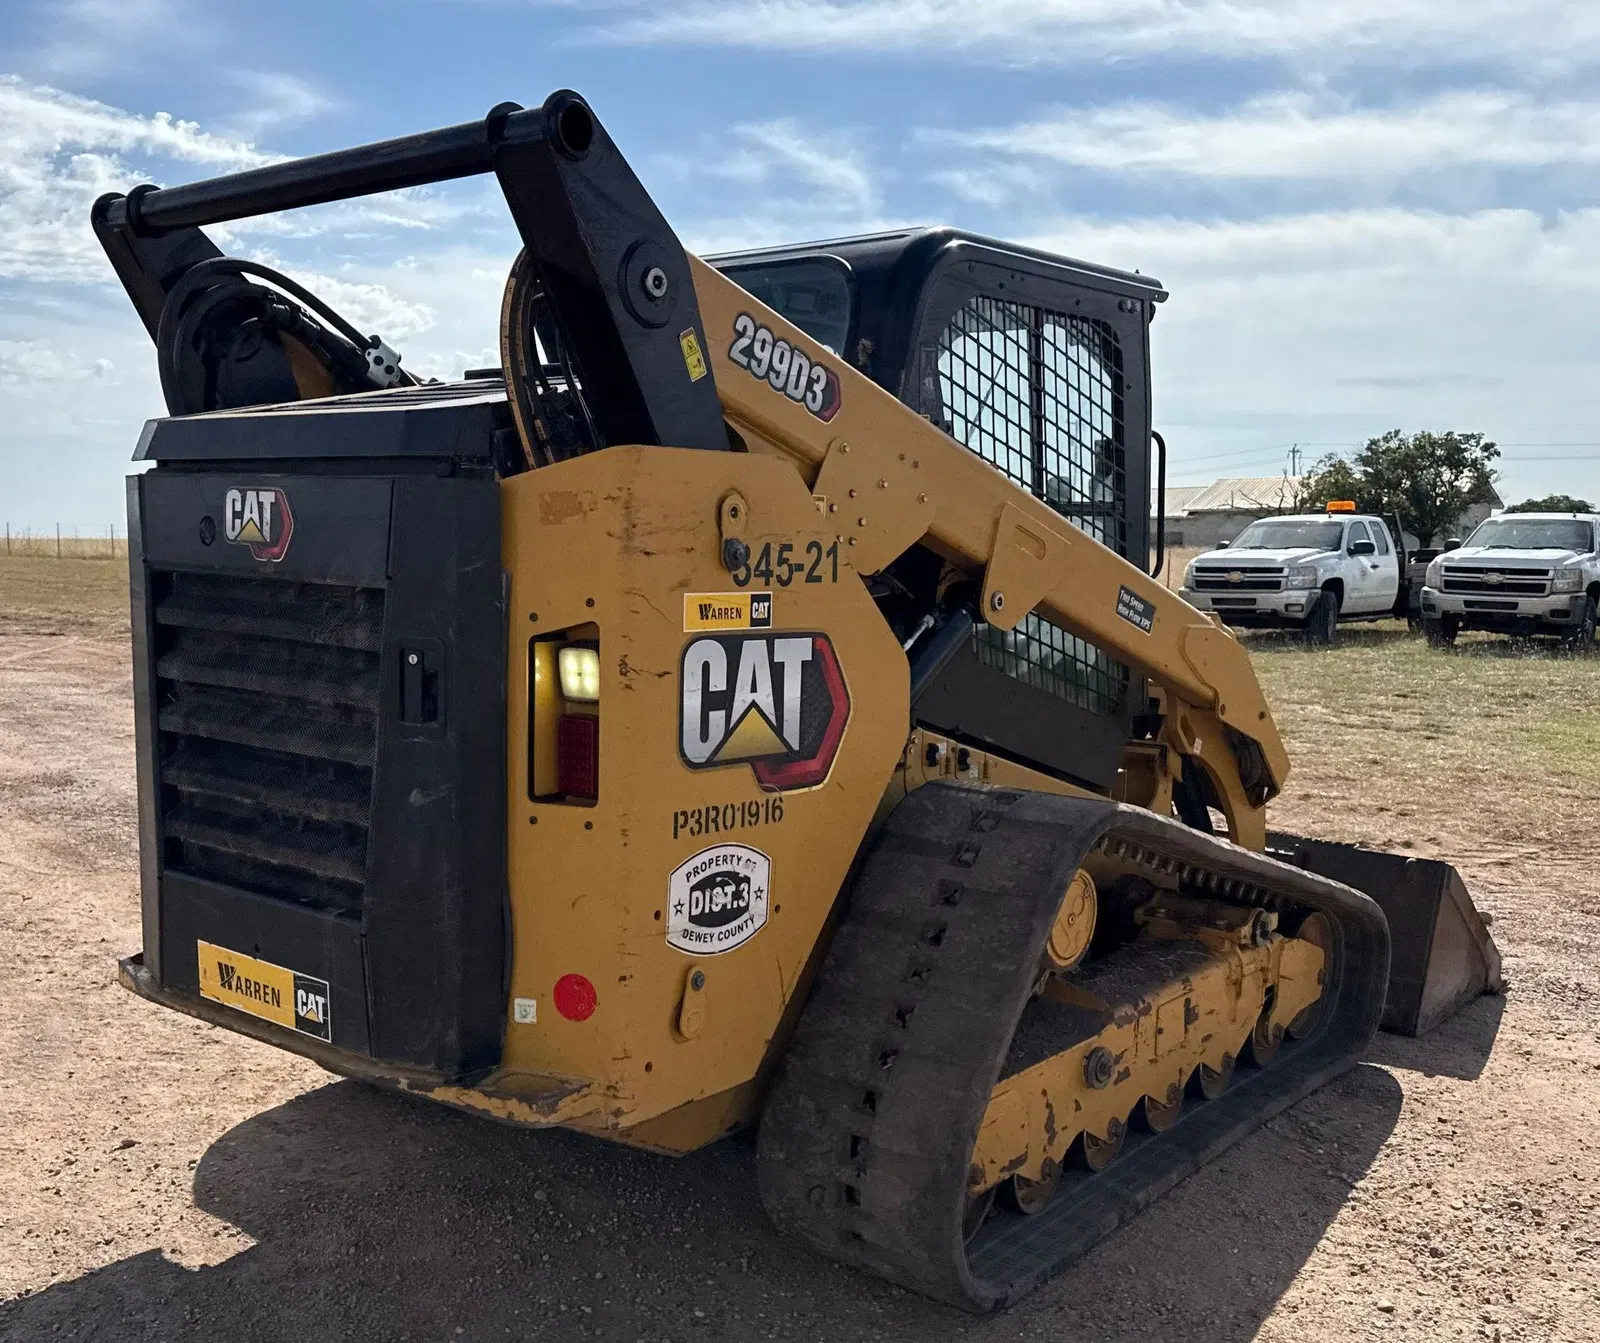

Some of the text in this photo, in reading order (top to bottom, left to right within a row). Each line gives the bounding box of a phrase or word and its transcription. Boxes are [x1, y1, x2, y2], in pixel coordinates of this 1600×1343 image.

[729, 314, 828, 412] 299D3
[225, 488, 276, 542] CAT
[698, 601, 770, 621] WARREN CAT
[682, 637, 813, 764] CAT
[673, 796, 784, 840] P3R01916
[685, 854, 743, 883] PROPERTY
[682, 914, 756, 943] DEWEY COUNTY
[217, 961, 326, 1024] WARREN CAT
